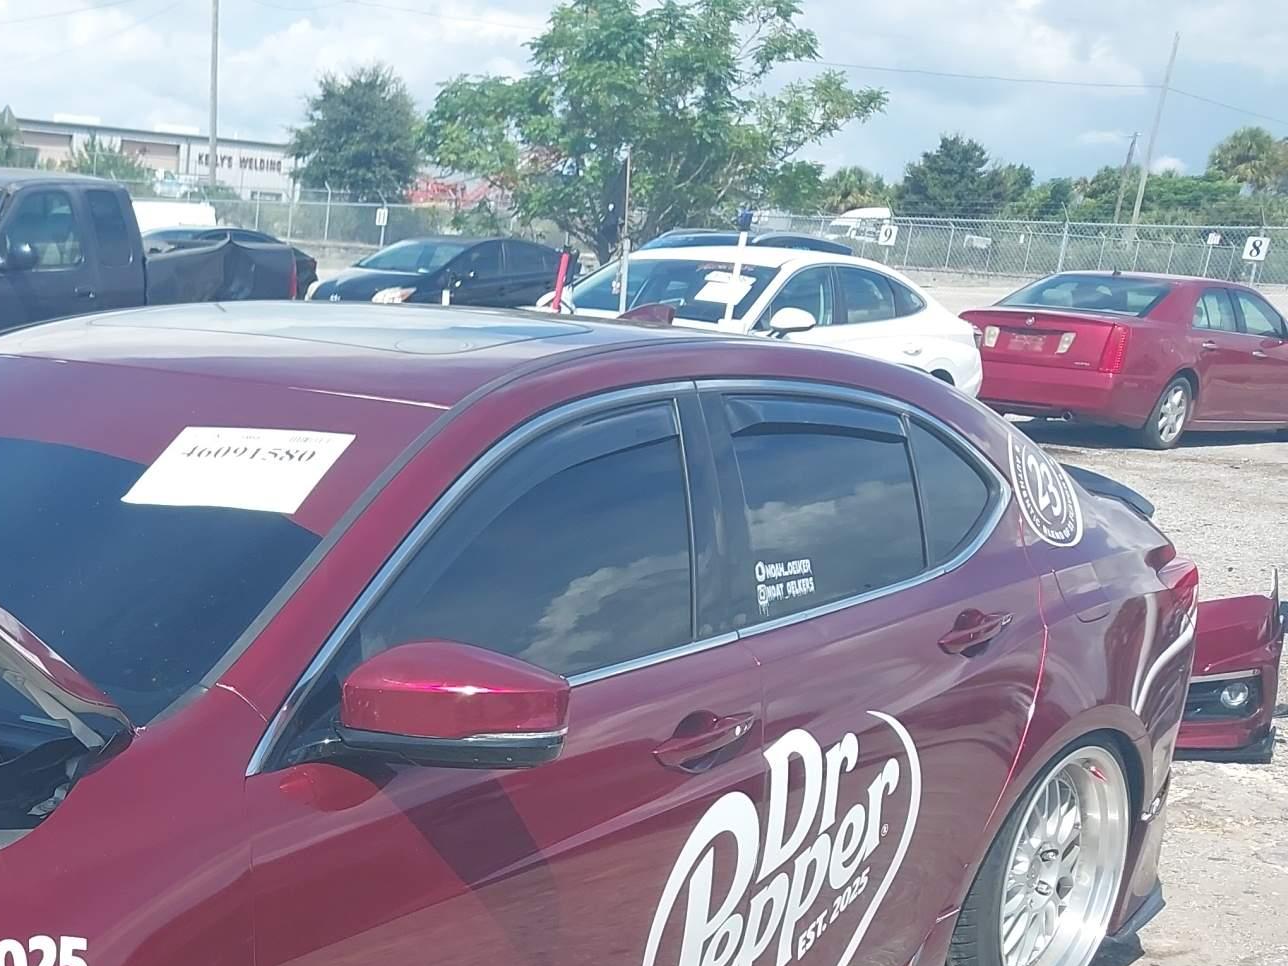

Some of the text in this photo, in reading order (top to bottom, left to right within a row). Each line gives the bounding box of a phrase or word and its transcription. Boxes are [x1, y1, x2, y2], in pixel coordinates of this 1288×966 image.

[239, 156, 282, 173] WELDING
[883, 227, 893, 242] 9
[1249, 239, 1263, 257] 8
[181, 444, 316, 462] 46091580
[1027, 454, 1062, 517] 23
[755, 728, 859, 884] Dr
[798, 866, 870, 960] EST. 2025
